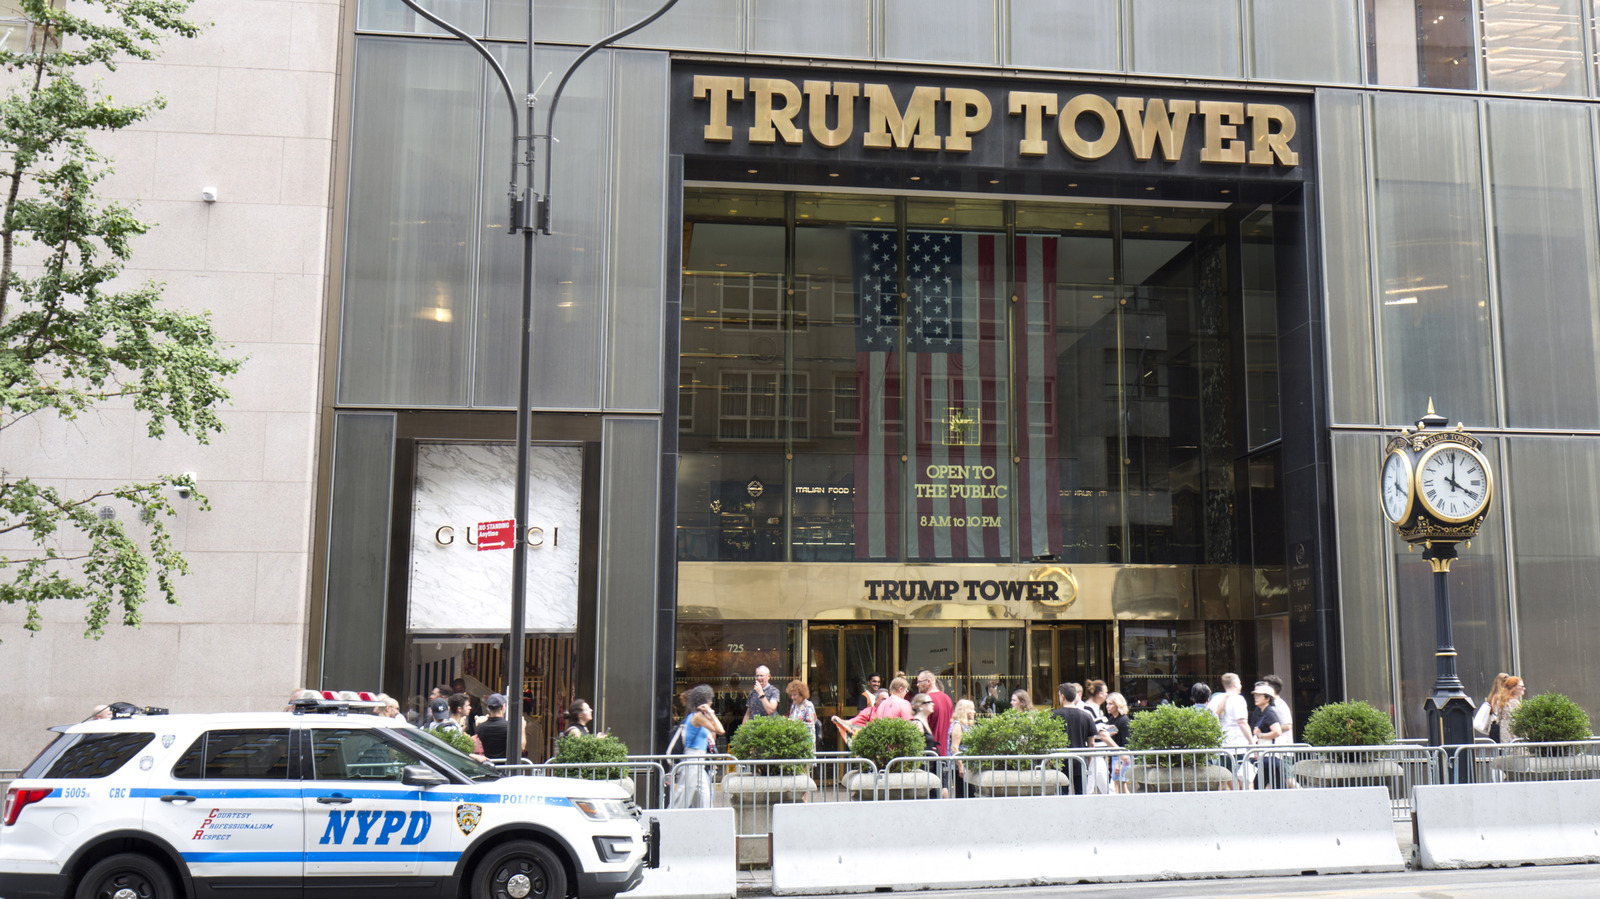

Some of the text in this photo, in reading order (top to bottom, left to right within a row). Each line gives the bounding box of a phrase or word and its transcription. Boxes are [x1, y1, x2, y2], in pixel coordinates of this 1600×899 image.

[693, 75, 1300, 167] TRUMP TOWER
[1425, 434, 1474, 446] TRUMP TOWER
[926, 465, 995, 480] OPEN TO
[915, 484, 1007, 499] THE PUBLIC
[487, 522, 509, 530] STANDING
[920, 516, 1001, 527] 8 AM to 10 PM
[435, 525, 558, 546] GUCI
[478, 530, 499, 538] Anytime
[864, 580, 1059, 600] TRUMP TOWER
[727, 644, 744, 653] 725
[65, 787, 86, 798] 5005
[109, 788, 127, 798] CRC
[501, 794, 542, 805] POLICE
[209, 808, 252, 819] COURTESY
[200, 819, 274, 829] PROFESSIONALISM
[319, 810, 432, 846] NYPD
[192, 830, 232, 840] RESPECT
